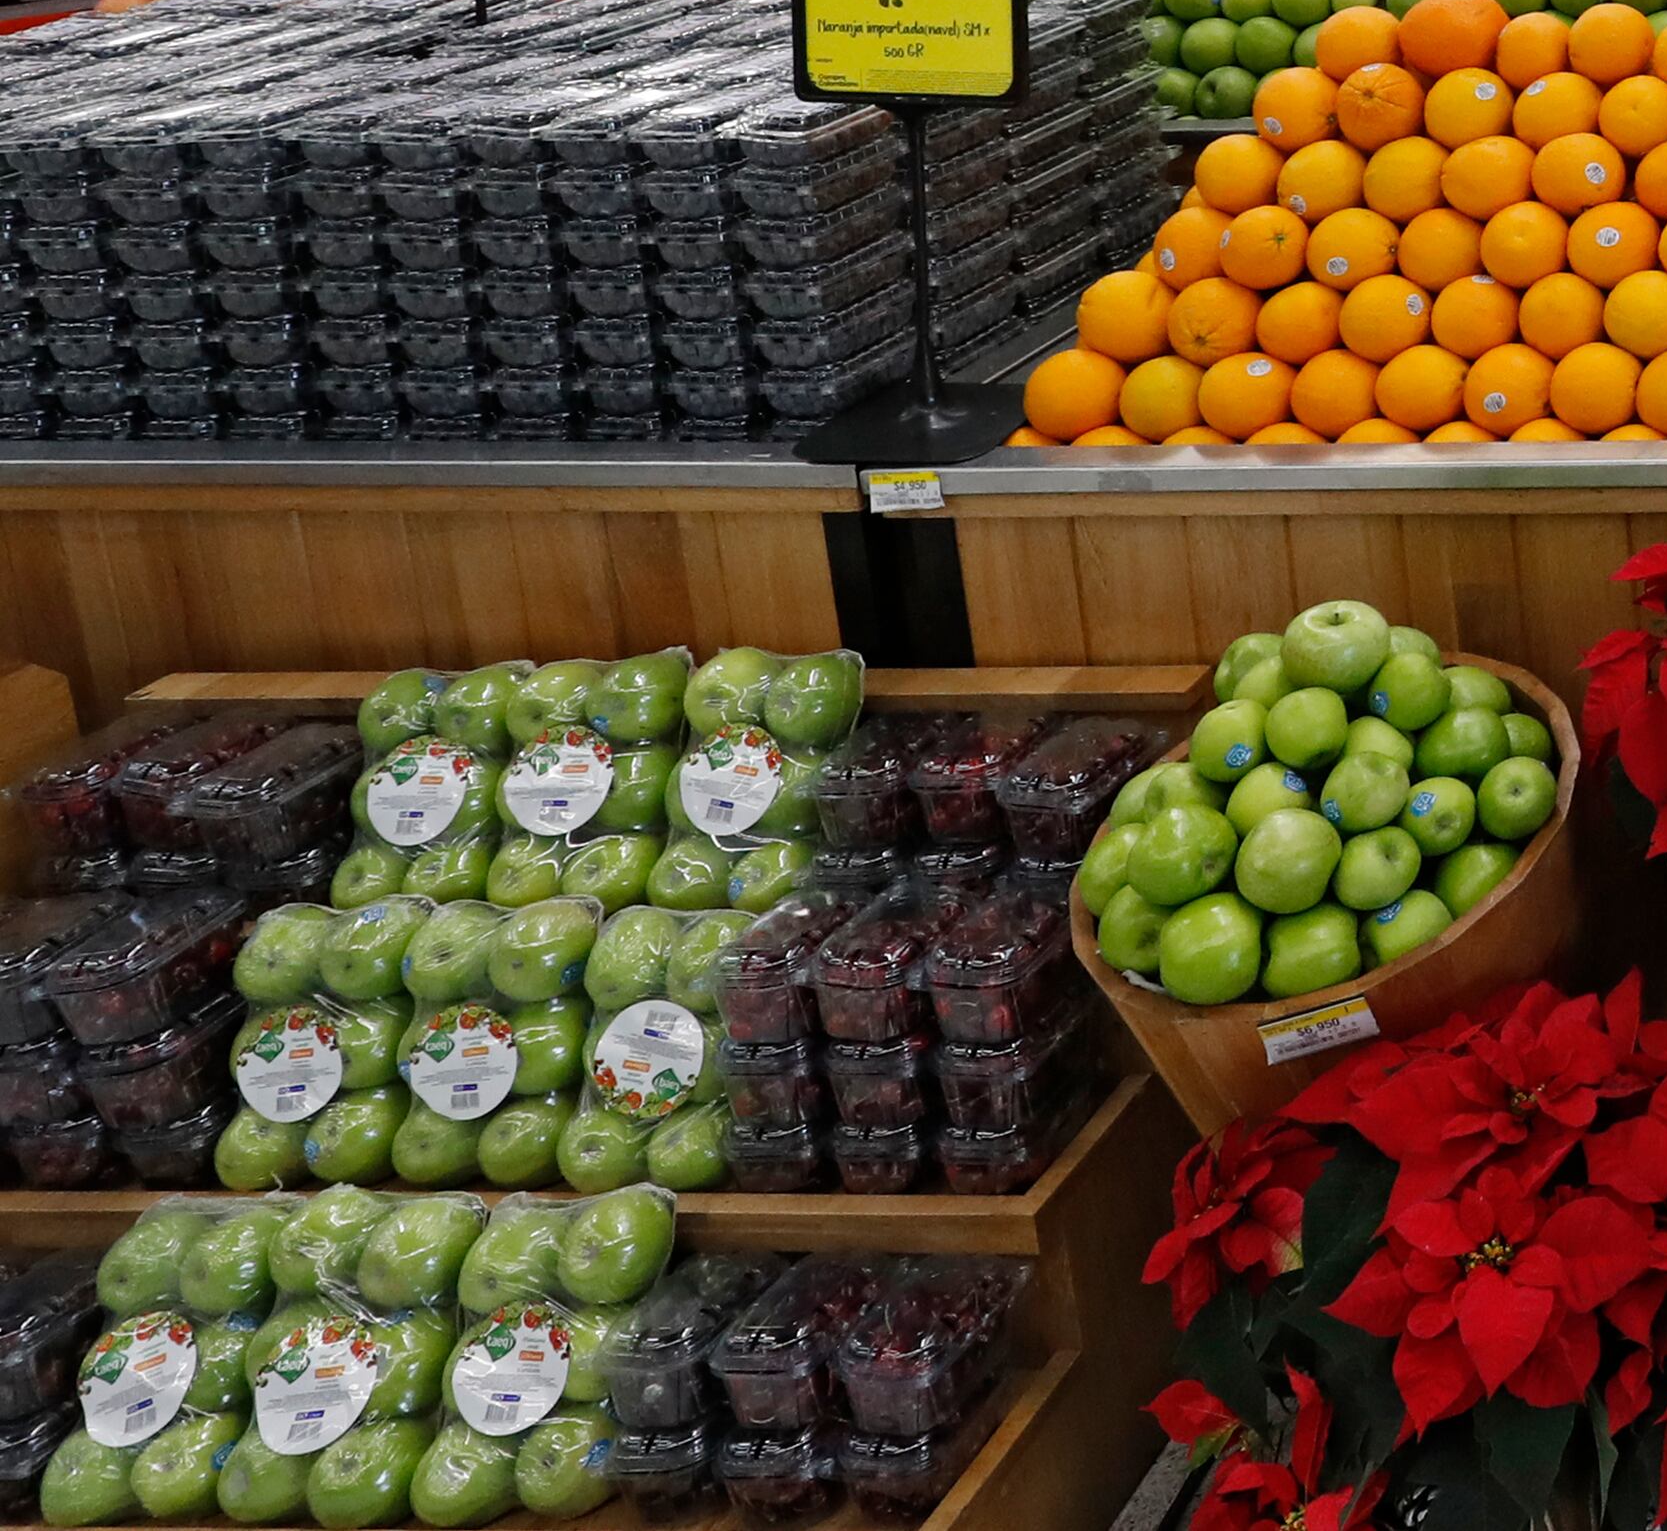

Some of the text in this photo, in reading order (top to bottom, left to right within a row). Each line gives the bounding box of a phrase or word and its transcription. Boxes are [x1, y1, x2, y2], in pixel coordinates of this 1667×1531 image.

[817, 18, 864, 39] Naranja
[963, 23, 982, 37] SM
[884, 42, 925, 58] 500 GR
